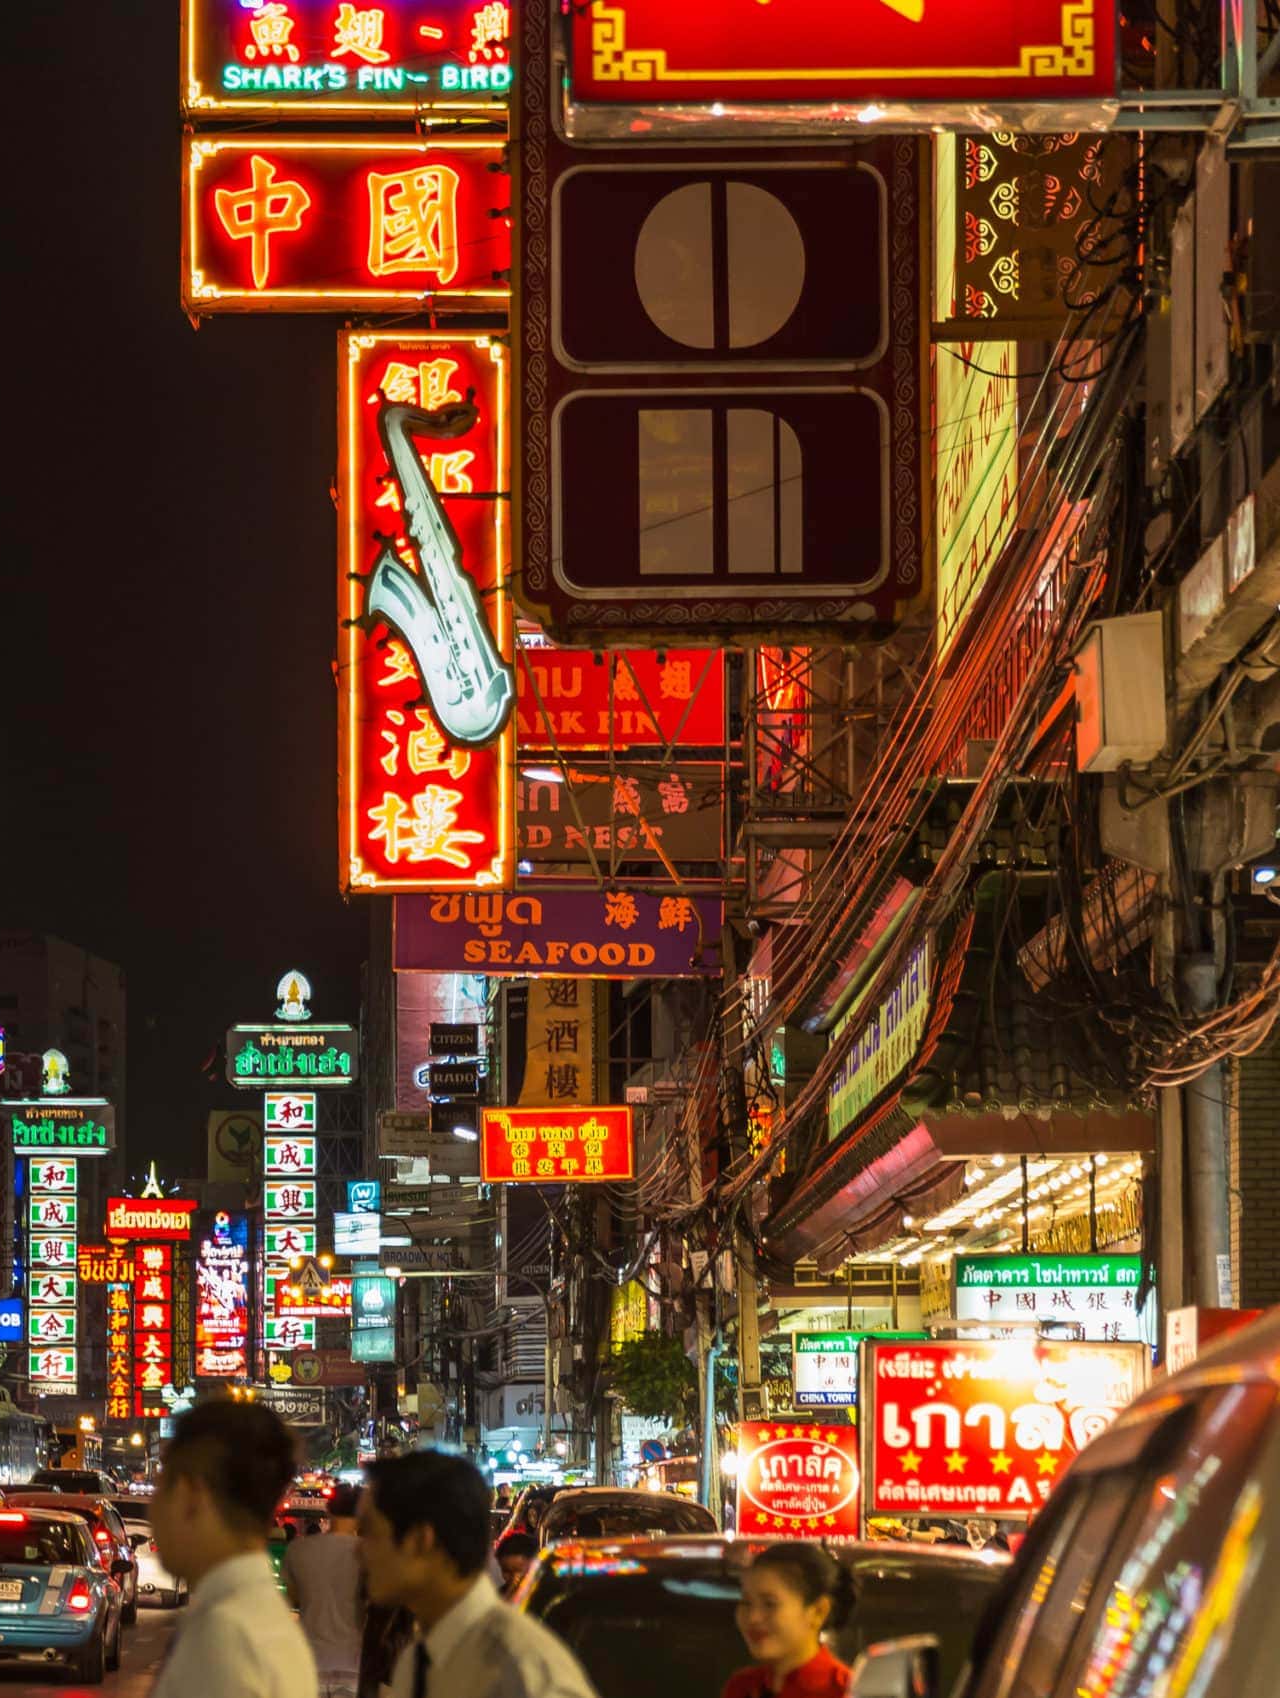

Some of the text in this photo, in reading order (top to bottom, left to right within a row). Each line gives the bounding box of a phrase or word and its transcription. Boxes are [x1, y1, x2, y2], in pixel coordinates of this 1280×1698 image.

[224, 64, 346, 90] SHARK'S
[215, 155, 460, 289] 中國
[942, 351, 1010, 537] CHINA TOWN
[564, 825, 663, 849] NEST
[604, 892, 694, 931] 海鮮
[463, 940, 656, 966] SEAFOOD
[432, 1034, 474, 1044] CITIZEN
[433, 1073, 475, 1084] RADO
[278, 1101, 304, 1345] 和成興大行
[41, 1166, 66, 1376] 和成興大金行
[962, 1265, 1030, 1283] ภัตตาคาร
[800, 1393, 852, 1404] CHINA TOWN
